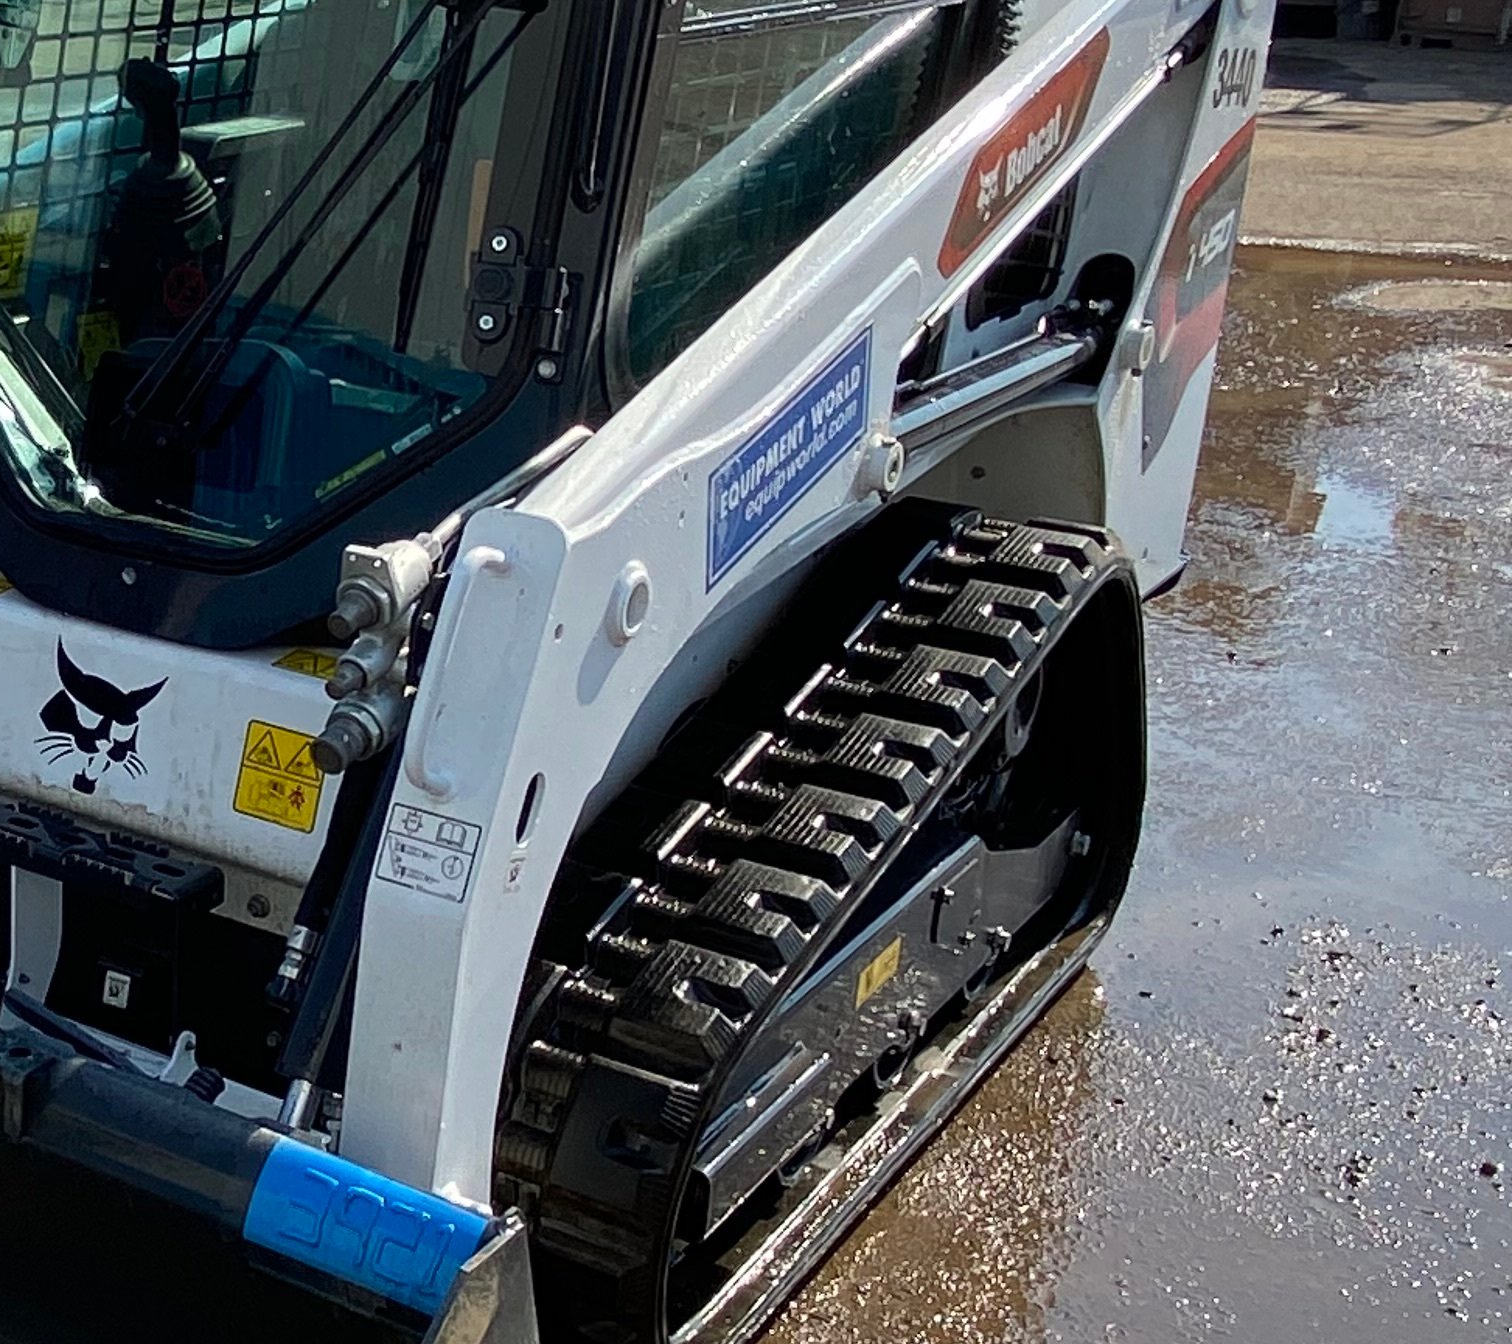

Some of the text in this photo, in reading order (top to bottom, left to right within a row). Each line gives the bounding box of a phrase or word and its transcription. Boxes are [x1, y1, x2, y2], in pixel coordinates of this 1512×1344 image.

[1212, 46, 1257, 109] 3440
[1004, 103, 1063, 197] Bobcat
[719, 363, 862, 520] EQUIPMENT WORLD
[745, 398, 858, 522] equipworld.com
